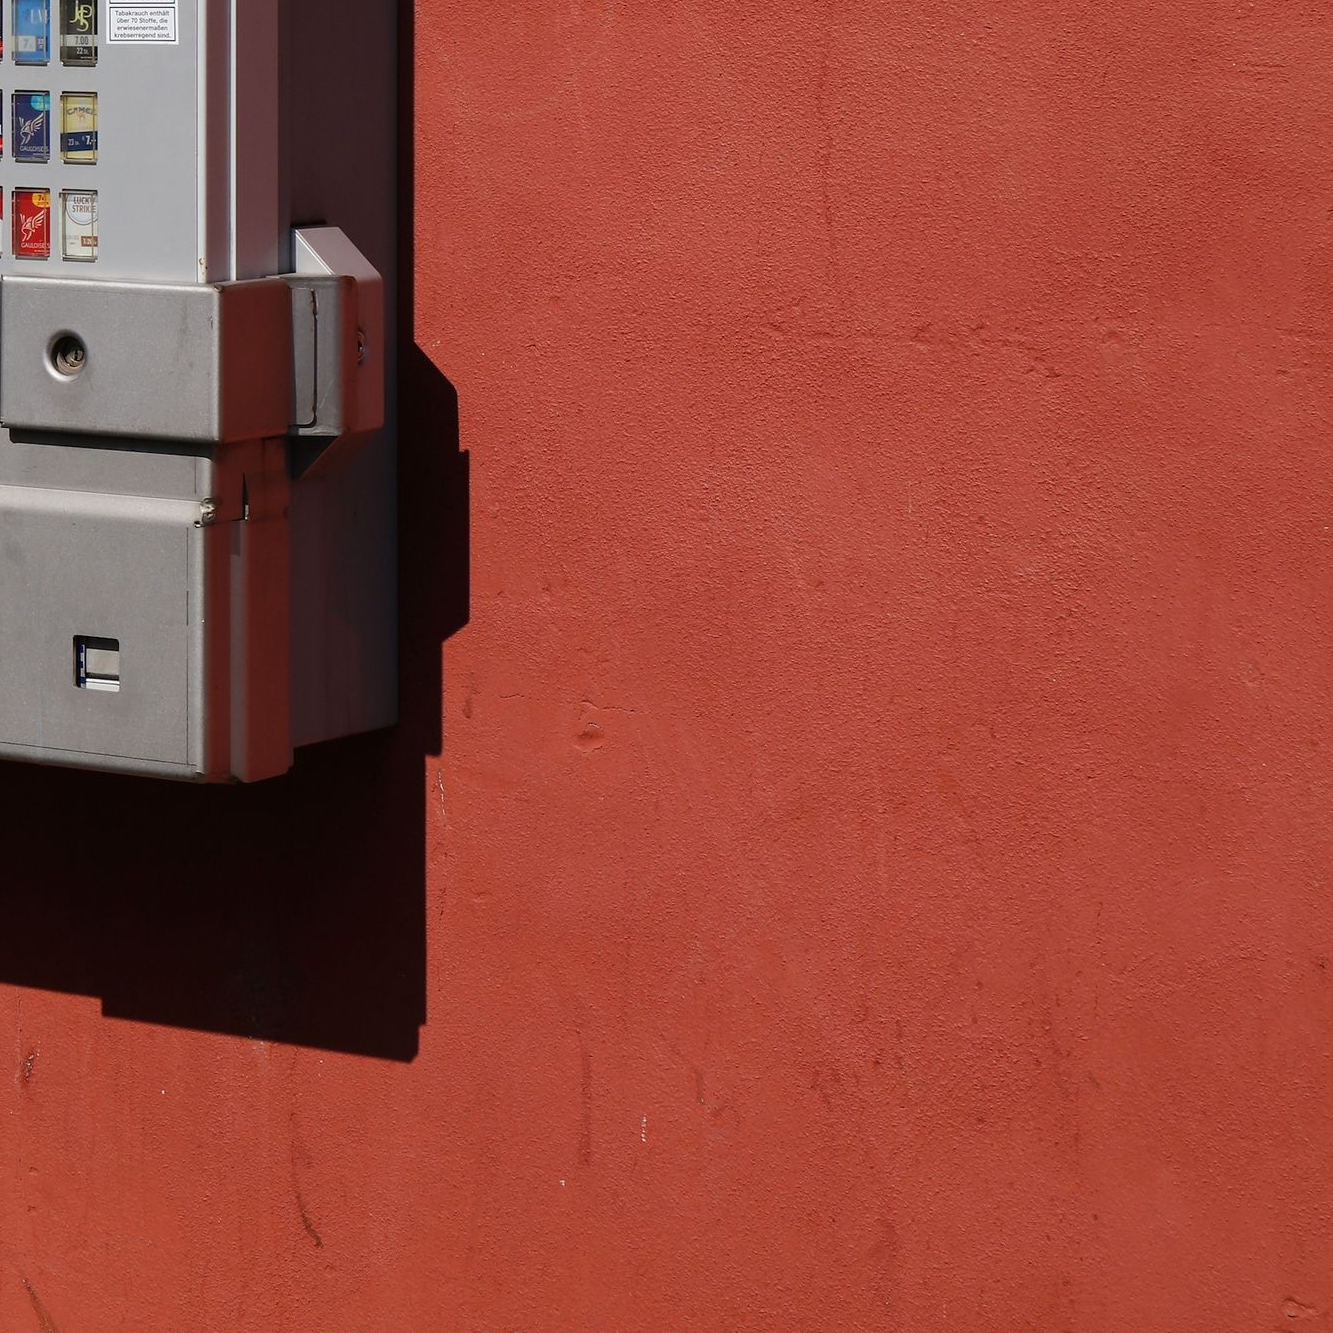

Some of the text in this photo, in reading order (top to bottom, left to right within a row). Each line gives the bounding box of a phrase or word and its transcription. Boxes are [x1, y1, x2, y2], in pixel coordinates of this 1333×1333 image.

[139, 17, 158, 25] Stoffe,
[114, 32, 157, 40] krebserregend
[66, 106, 97, 116] CAMEL
[73, 196, 96, 205] LUCKY
